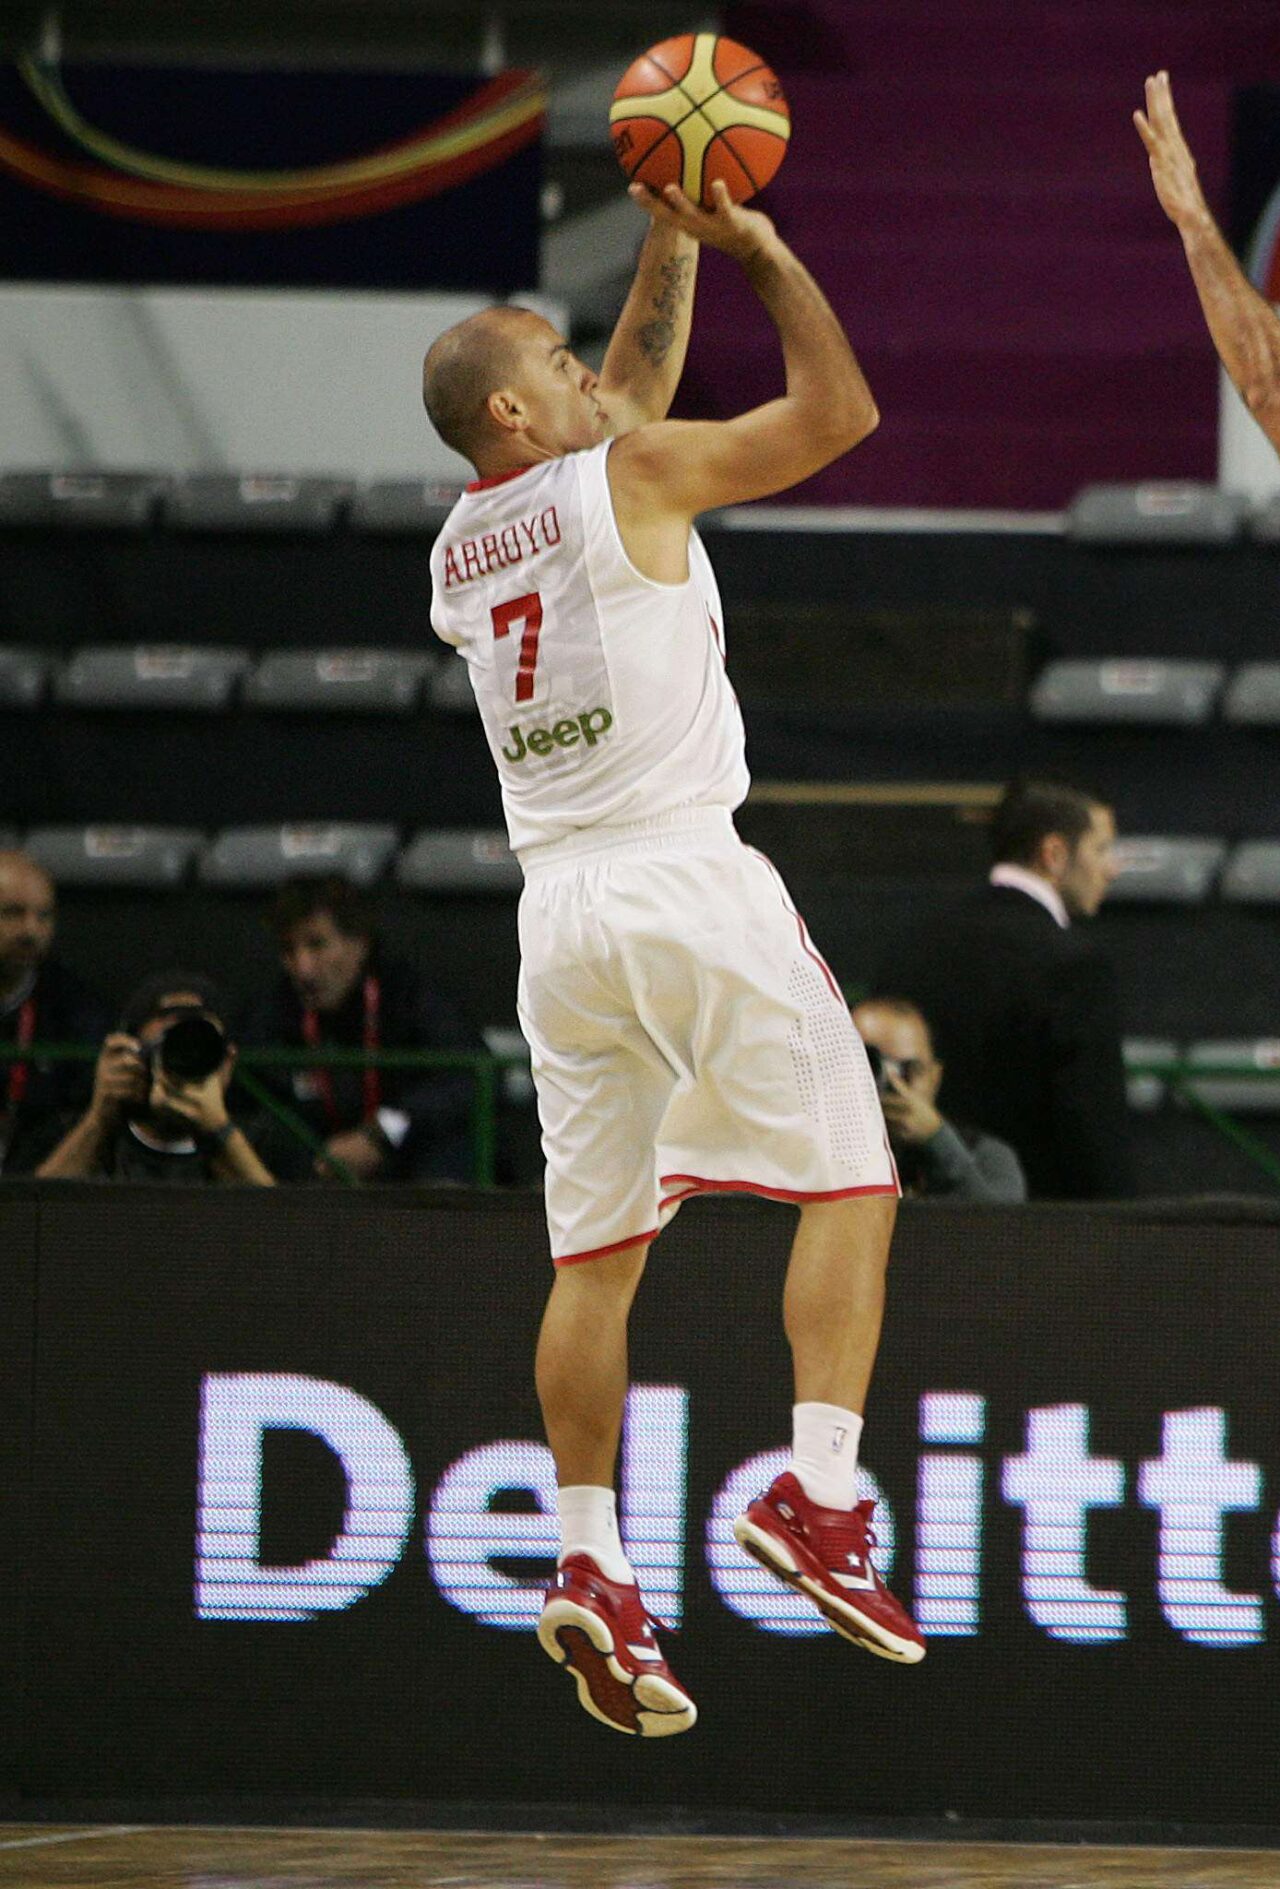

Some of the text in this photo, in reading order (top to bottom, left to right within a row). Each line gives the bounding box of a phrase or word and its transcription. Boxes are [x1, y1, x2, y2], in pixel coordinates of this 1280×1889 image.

[444, 506, 562, 587] ARROYO
[490, 592, 543, 702] 7
[502, 707, 613, 764] Jeep
